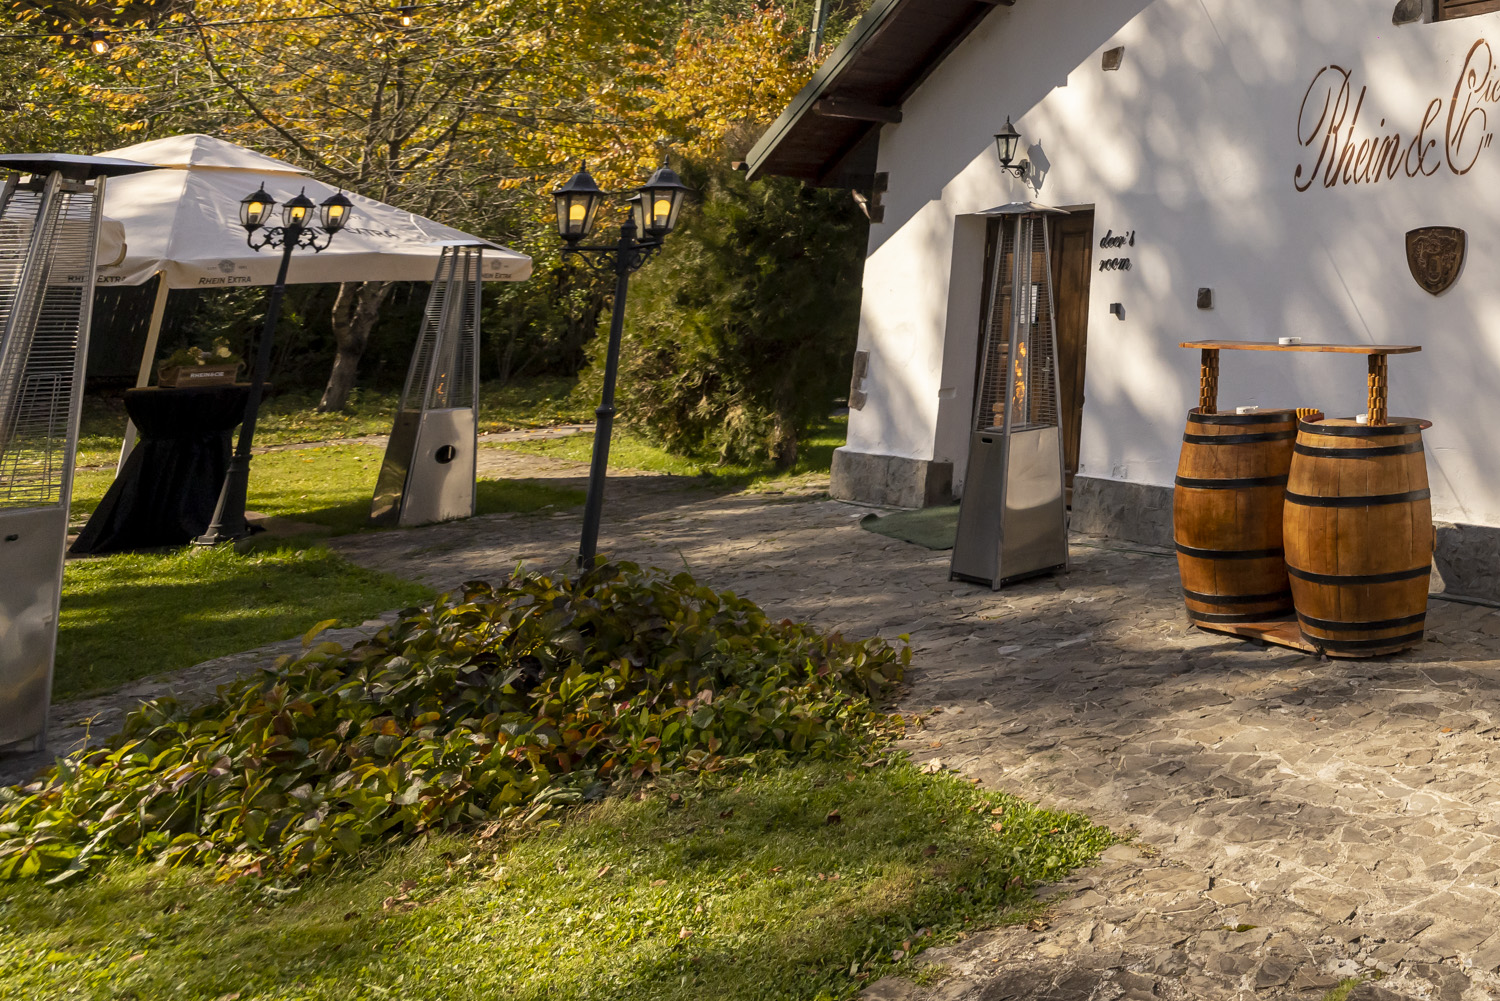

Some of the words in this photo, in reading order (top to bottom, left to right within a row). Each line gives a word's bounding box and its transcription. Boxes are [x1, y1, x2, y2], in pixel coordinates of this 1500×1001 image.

[1098, 257, 1132, 272] room
[198, 276, 225, 285] RHEIN
[227, 275, 252, 284] EXTRA
